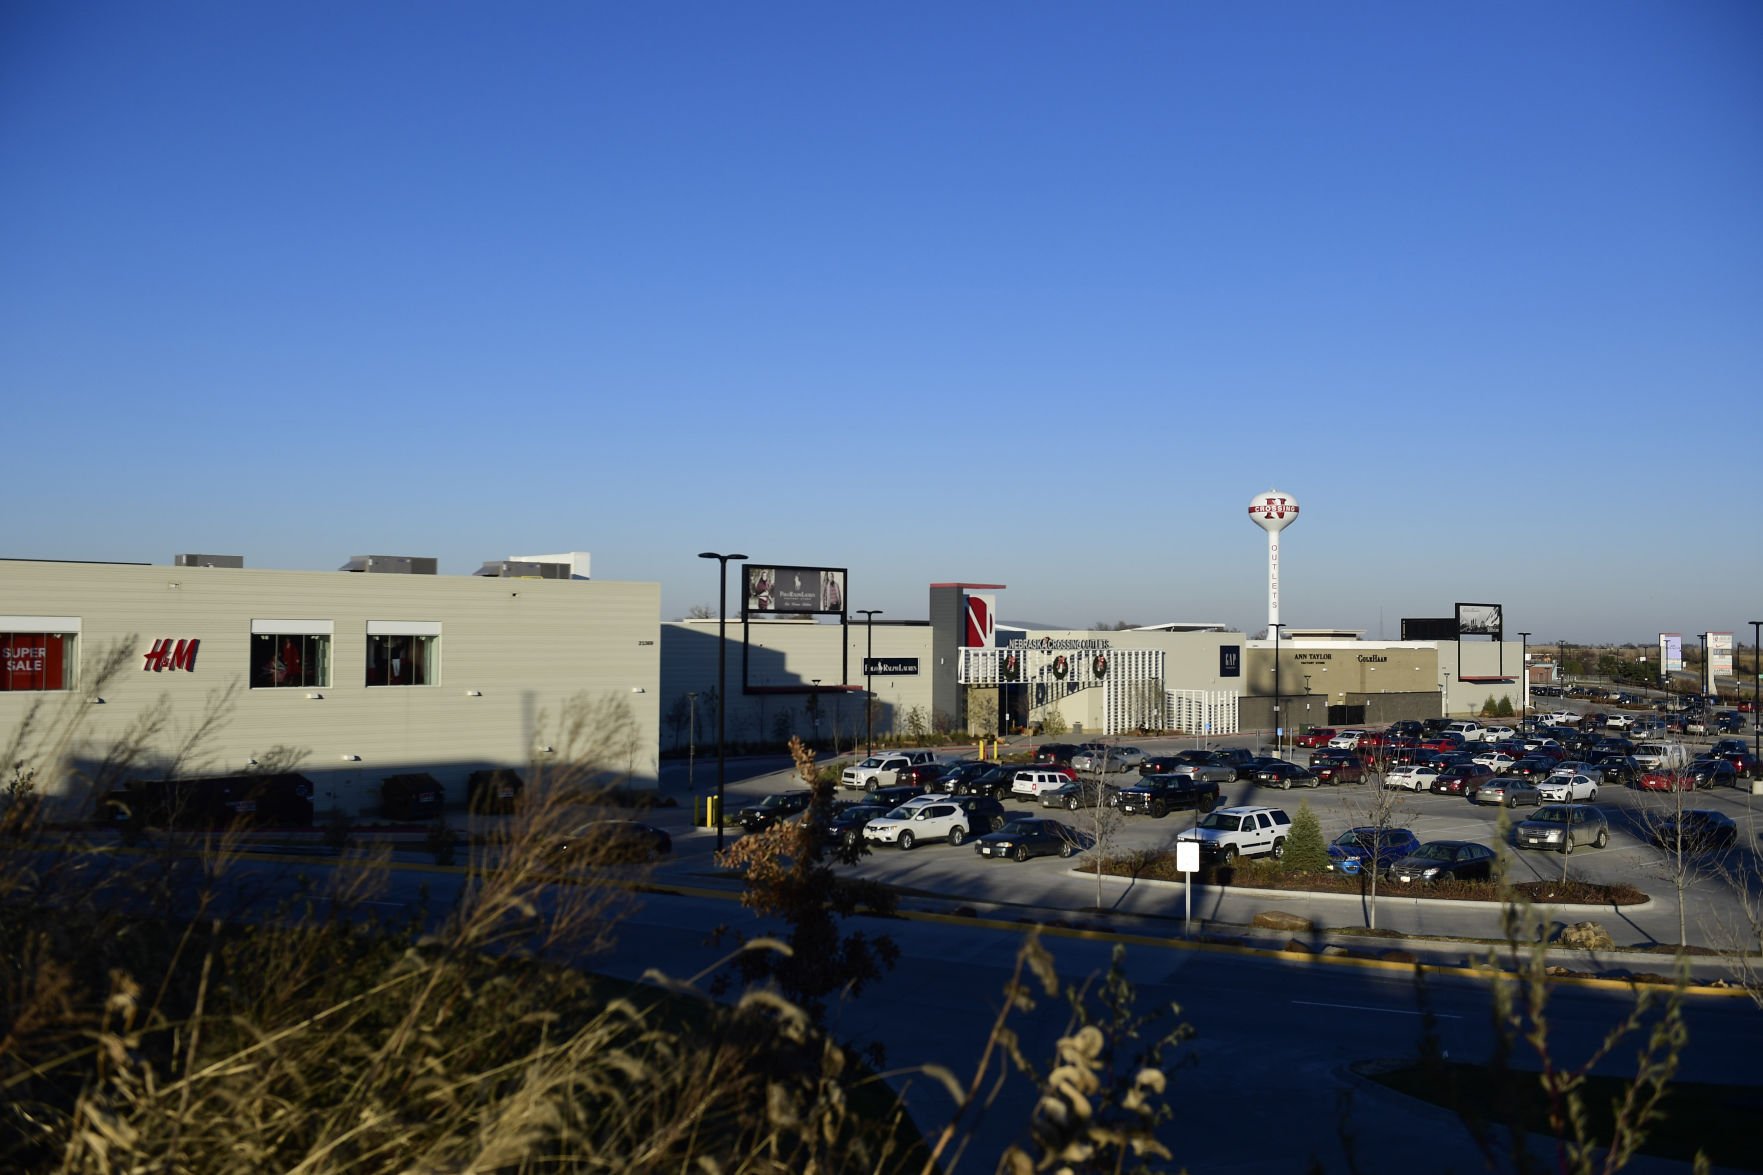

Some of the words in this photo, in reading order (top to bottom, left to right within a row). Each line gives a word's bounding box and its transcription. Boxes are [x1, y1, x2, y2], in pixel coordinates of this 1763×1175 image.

[1008, 639, 1046, 649] NEBRASKA
[1047, 639, 1080, 649] CROSSING
[1080, 639, 1110, 650] OUTLETS
[3, 647, 46, 658] SUPER
[143, 638, 200, 673] H&M
[6, 659, 43, 672] SALE
